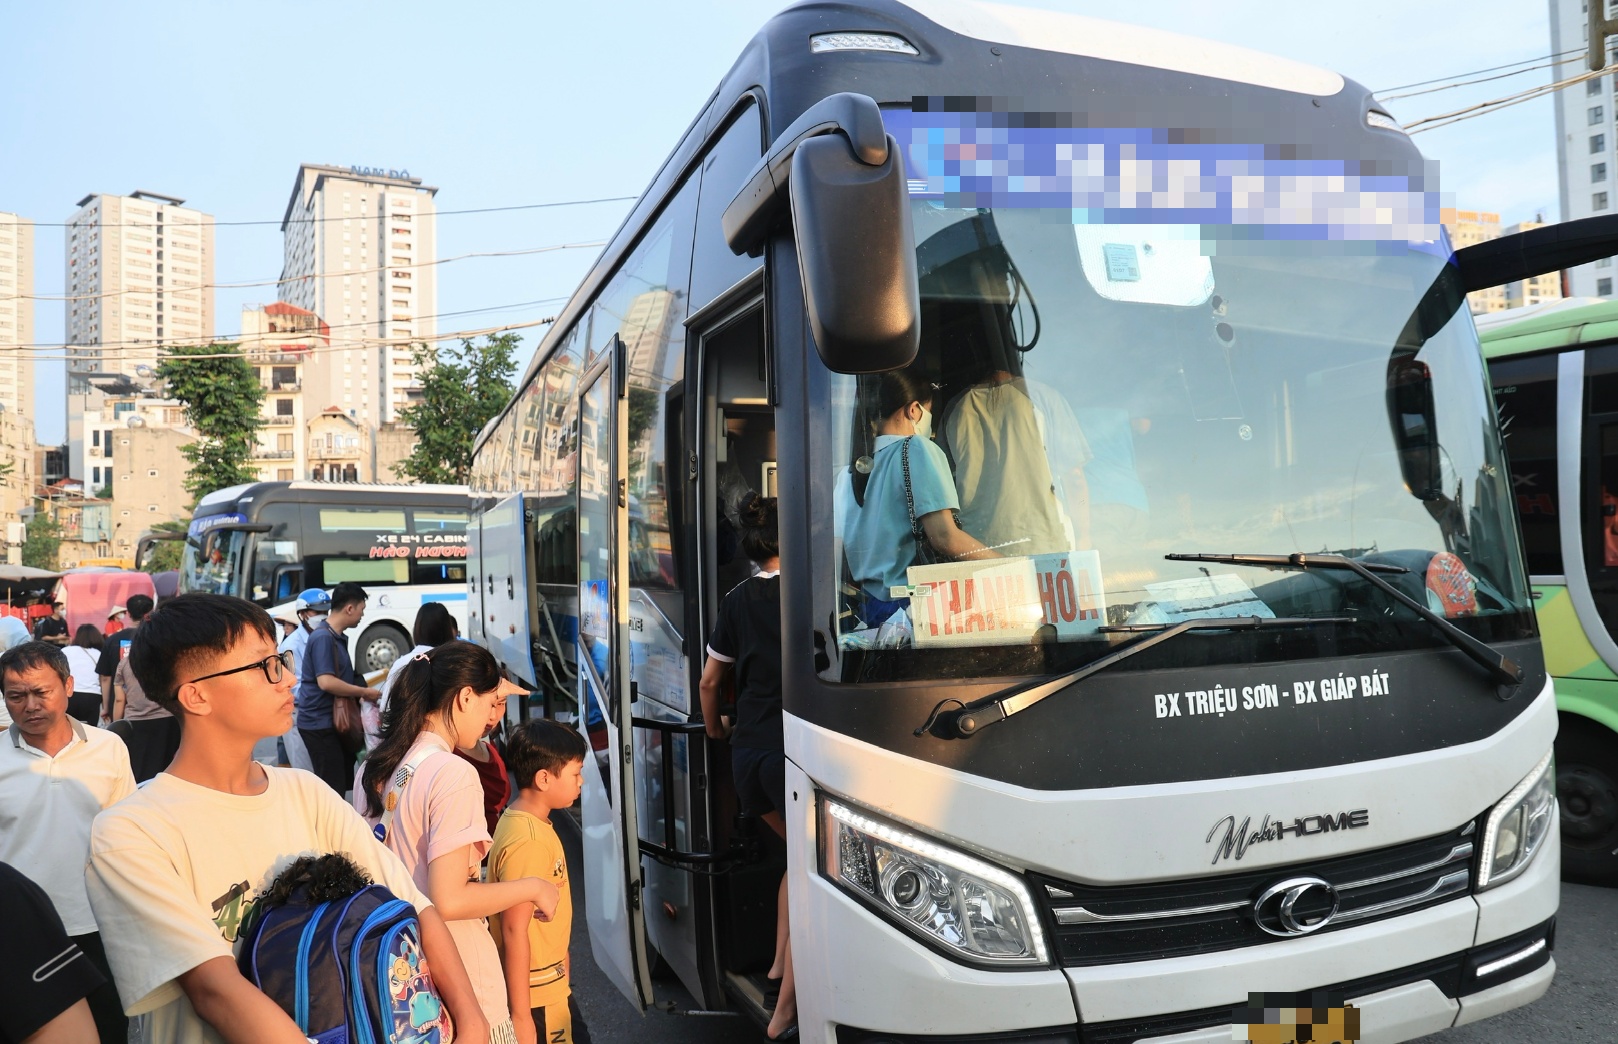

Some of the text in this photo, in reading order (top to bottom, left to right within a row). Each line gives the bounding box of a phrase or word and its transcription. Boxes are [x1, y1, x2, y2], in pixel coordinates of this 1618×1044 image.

[351, 165, 385, 177] NAM
[376, 535, 468, 543] XE 24 CABIN
[369, 544, 469, 558] HÀO HƯƠN
[920, 559, 1099, 636] THANH HÓA
[1155, 693, 1181, 718] BX
[1185, 684, 1237, 717] TRIỆU
[1242, 683, 1279, 710] SƠN
[1293, 681, 1318, 704] BX
[1320, 672, 1358, 701] GIÁP
[1361, 669, 1390, 697] BÁT
